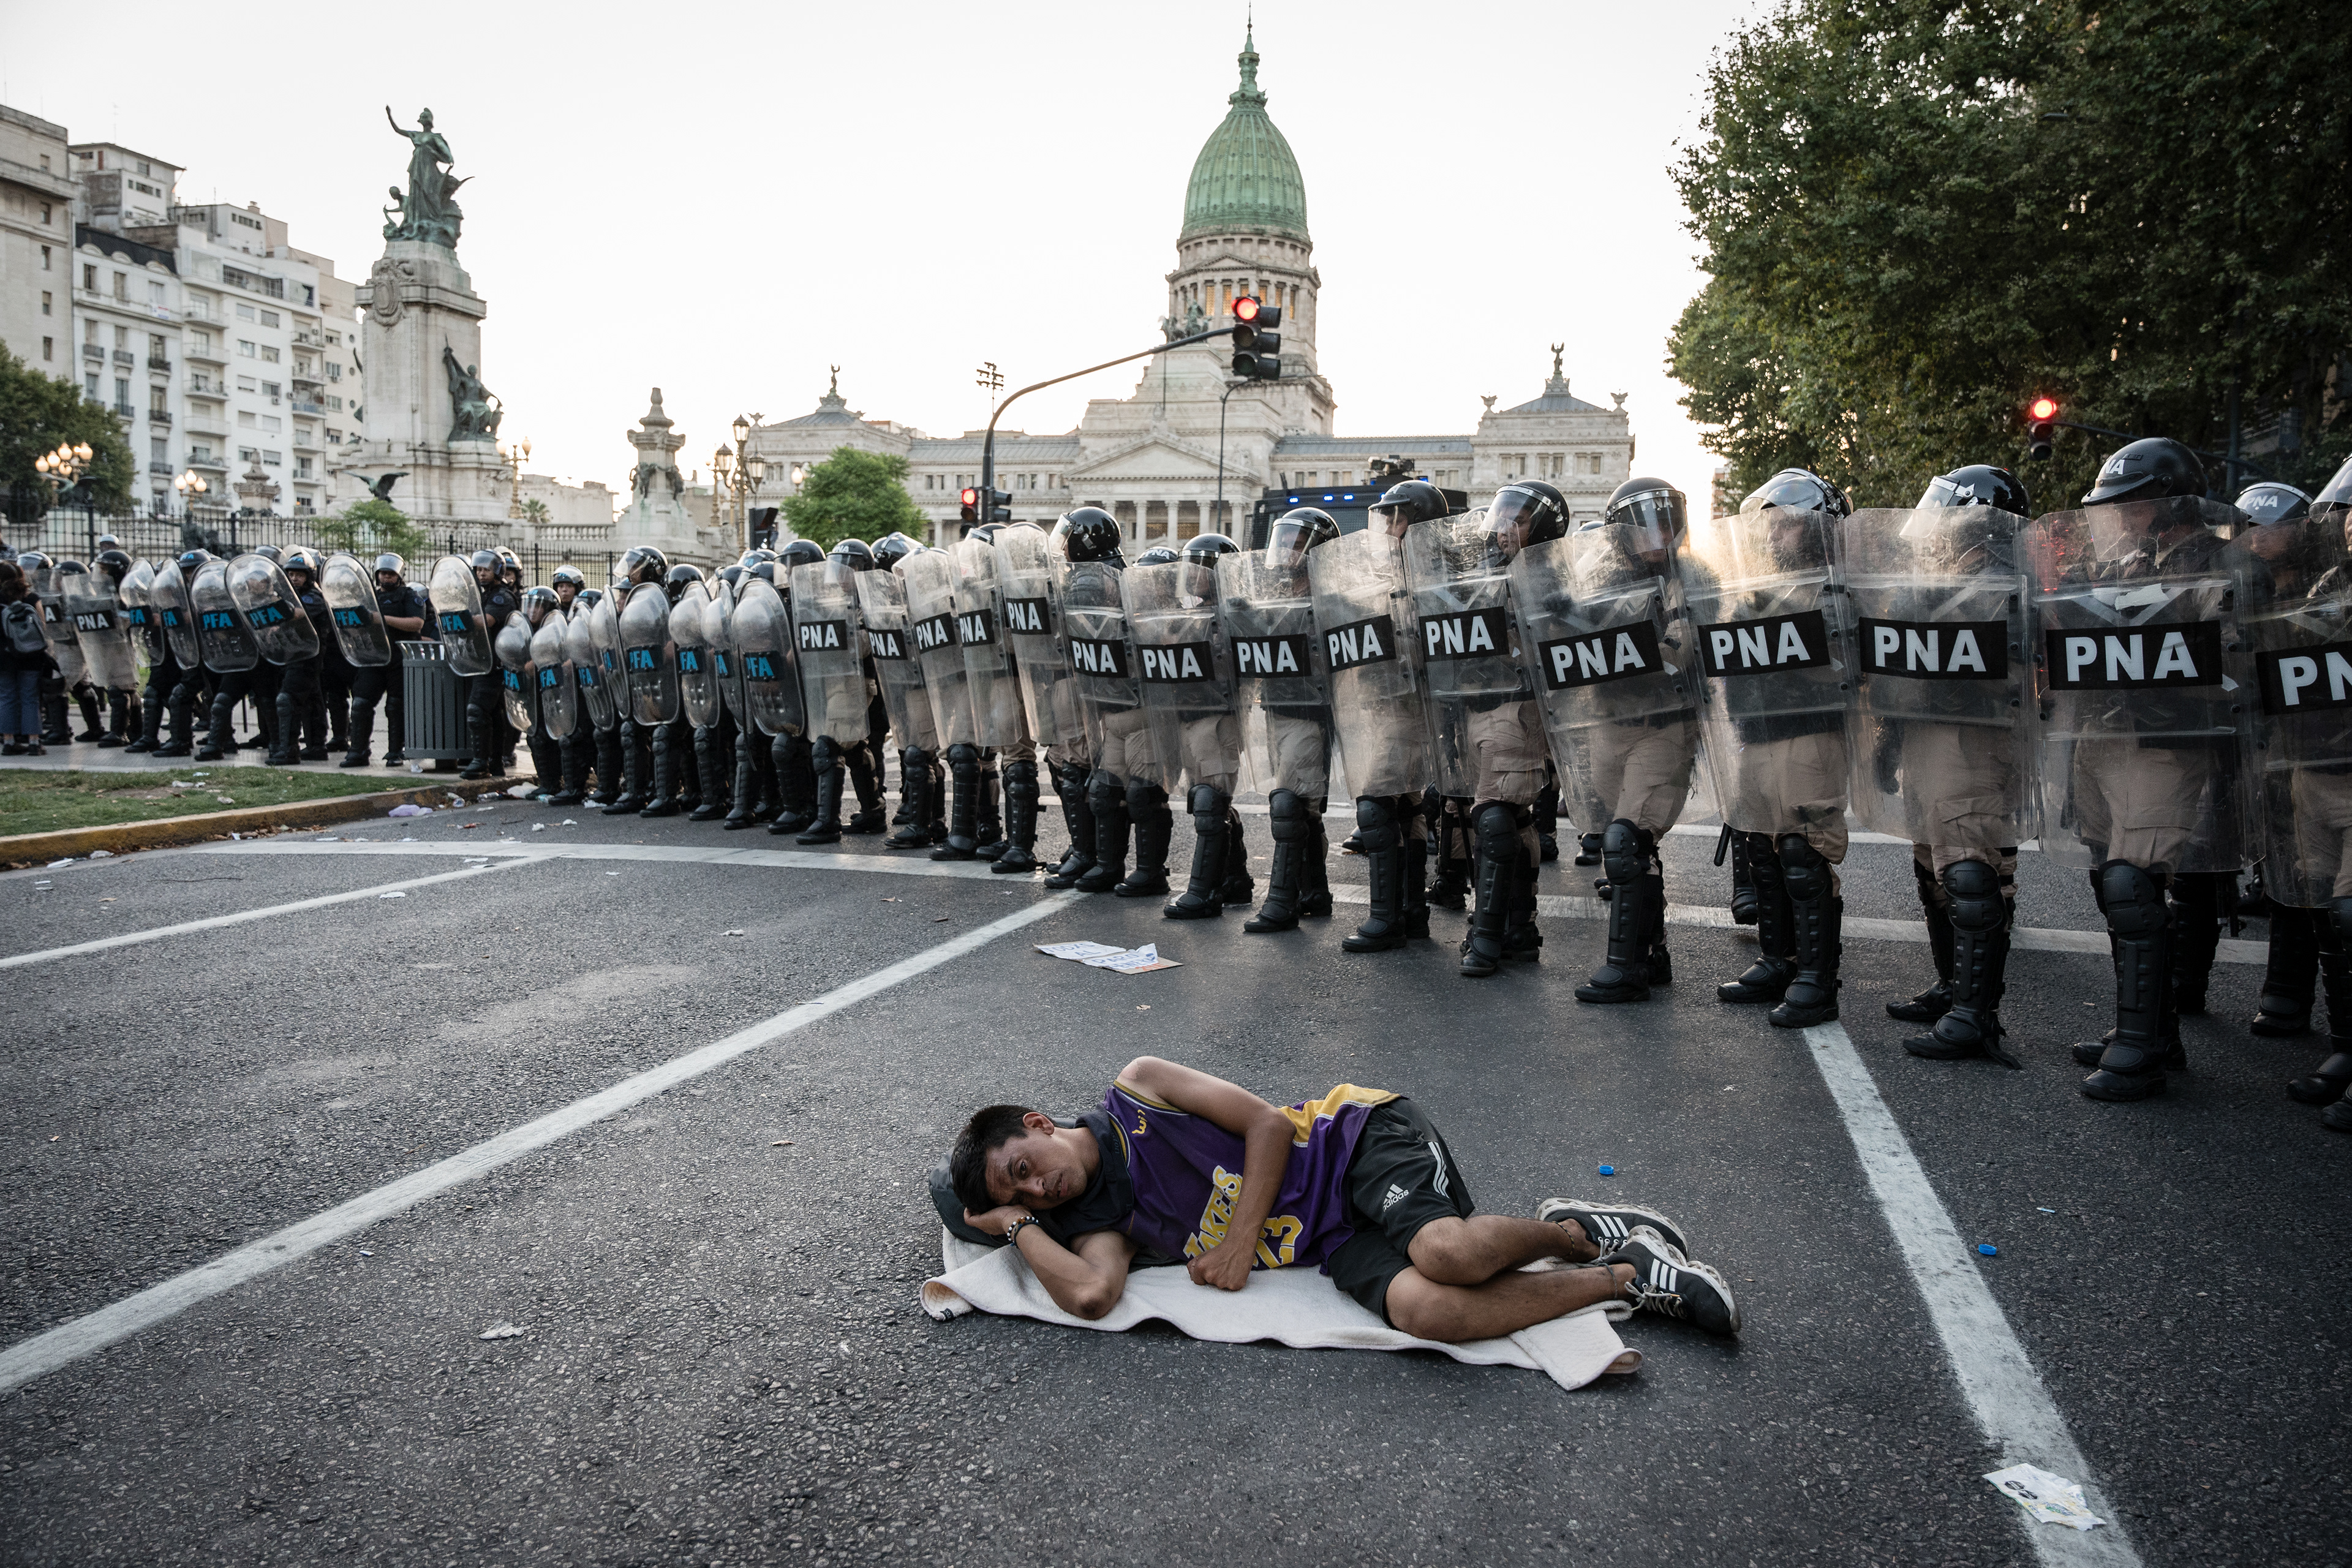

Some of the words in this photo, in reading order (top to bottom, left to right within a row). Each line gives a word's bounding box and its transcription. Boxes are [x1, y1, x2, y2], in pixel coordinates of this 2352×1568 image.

[2103, 459, 2125, 475] NA
[1640, 497, 1673, 511] PNA
[2244, 495, 2278, 510] PNA
[1145, 549, 1170, 560] PNA
[77, 613, 110, 631] PNA
[130, 609, 146, 624] FA
[203, 612, 234, 631] PFA
[249, 606, 284, 628] PFA
[960, 614, 987, 643] PNA
[1008, 602, 1042, 630] PNA
[801, 624, 840, 649] PNA
[869, 631, 900, 657] PNA
[916, 619, 949, 650] PNA
[1328, 624, 1384, 667] PNA
[1425, 615, 1495, 656] PNA
[1710, 621, 1811, 670] PNA
[679, 650, 699, 671] FA
[1072, 640, 1118, 673] PNA
[1237, 641, 1299, 673] PNA
[1550, 631, 1646, 683] PNA
[1874, 625, 1987, 673] PNA
[2065, 631, 2199, 682] PNA
[1142, 647, 1204, 679] PNA
[503, 669, 520, 691] FA
[2278, 651, 2352, 706] PN
[1092, 954, 1139, 964] PARO
[1382, 1189, 1409, 1212] adidas
